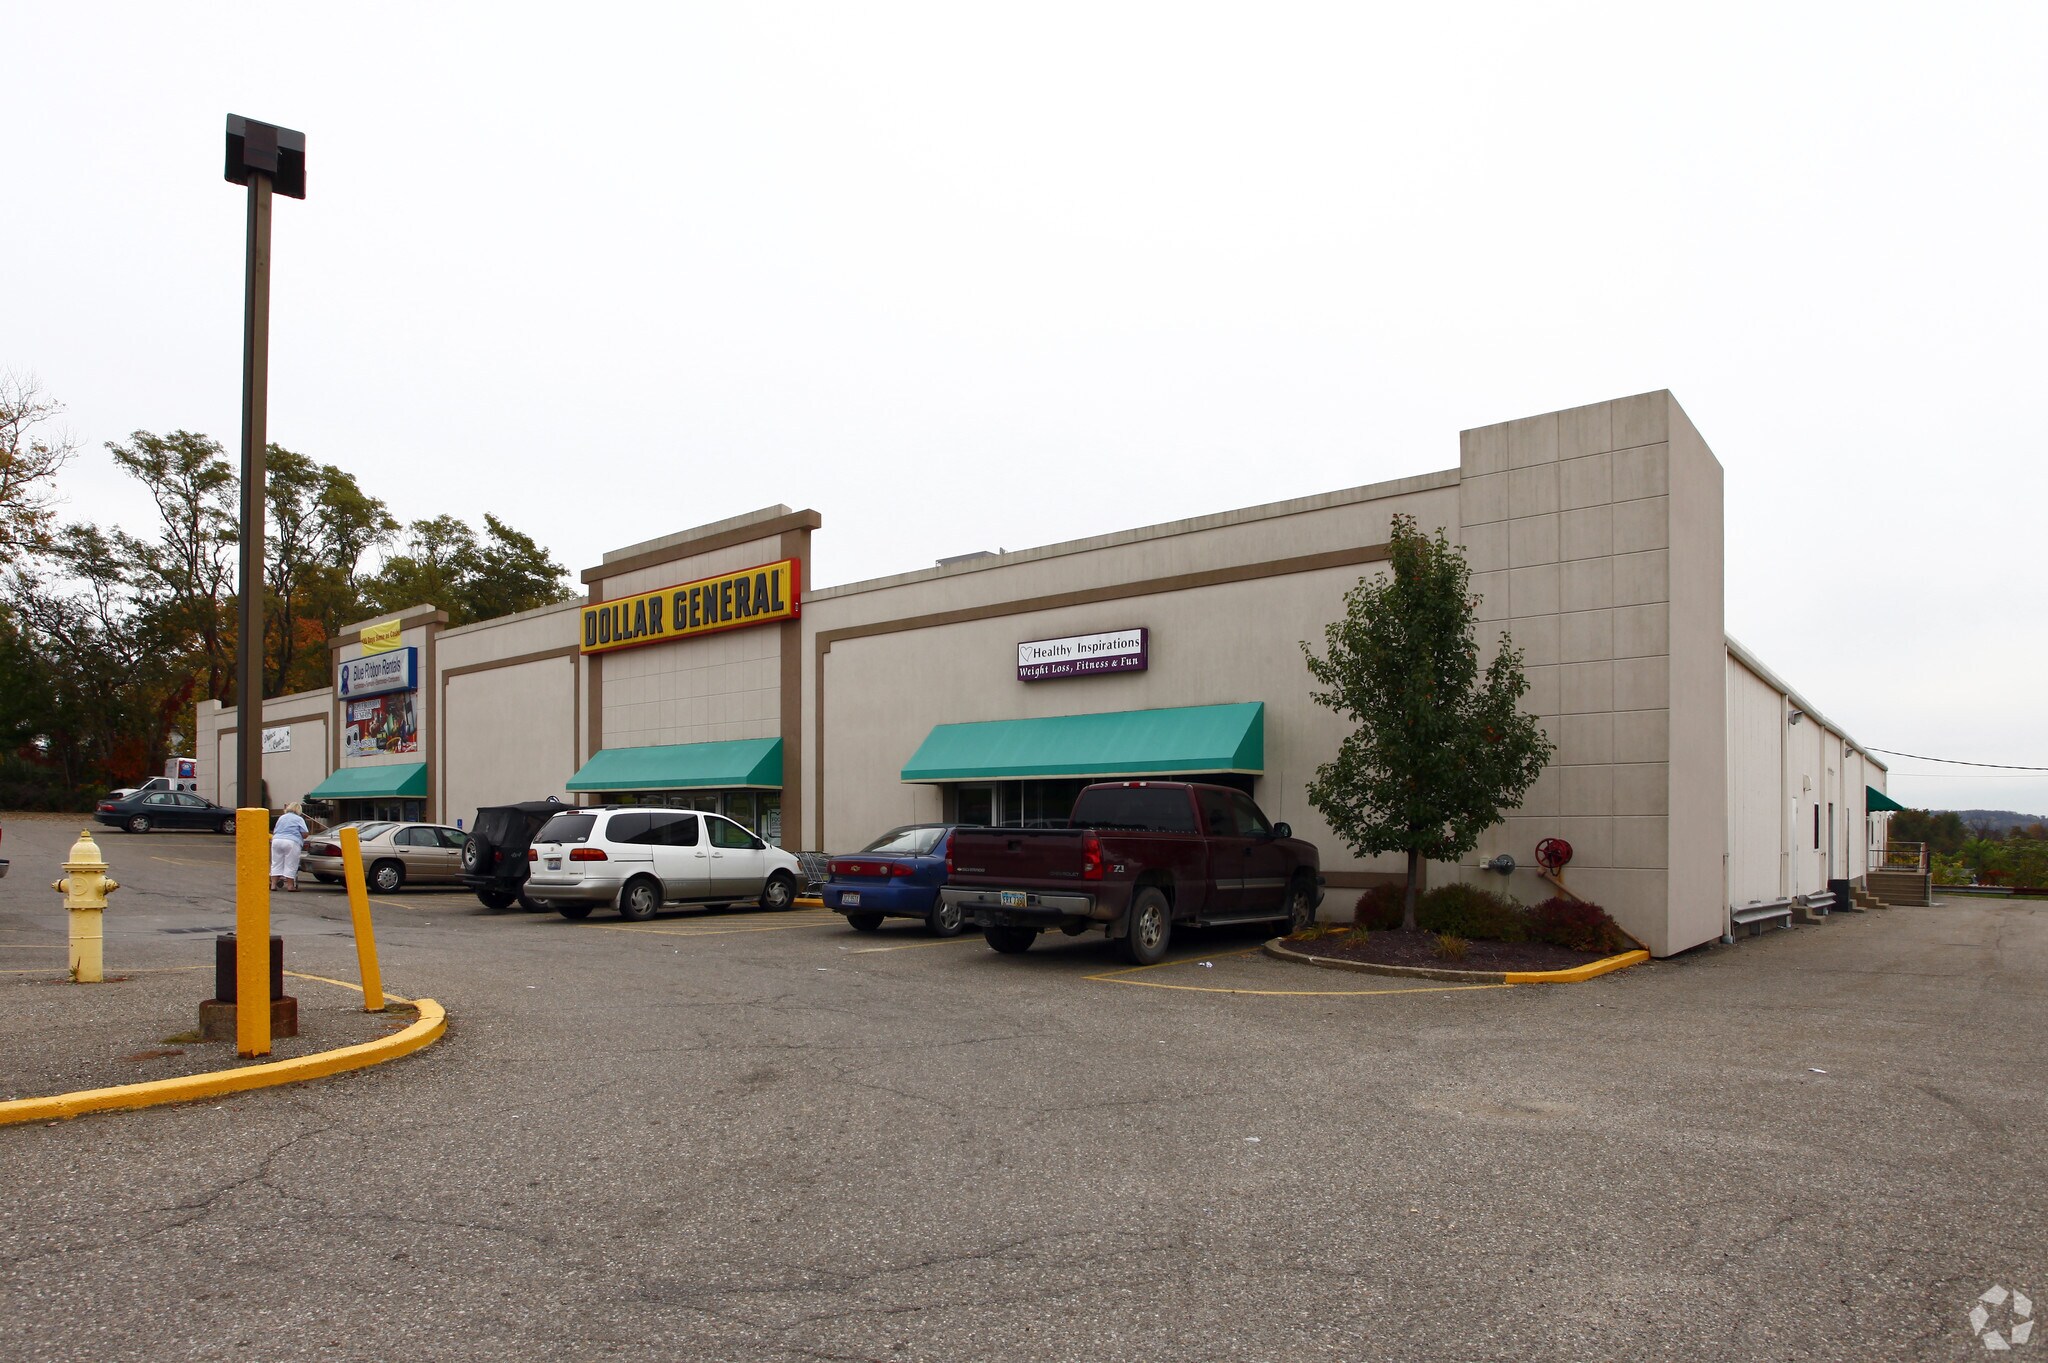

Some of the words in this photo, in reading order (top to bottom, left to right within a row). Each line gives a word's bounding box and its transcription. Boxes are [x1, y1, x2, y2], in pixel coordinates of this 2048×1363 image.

[585, 596, 663, 647] DOLLAR
[672, 569, 785, 630] GENERAL
[1033, 644, 1073, 659] Healthy
[1077, 637, 1140, 654] Inspirations
[353, 665, 365, 681] Blue
[364, 661, 381, 678] Ribbon
[382, 656, 401, 675] Rentals
[1019, 665, 1049, 678] Weight
[1052, 664, 1073, 674] Loss,
[1076, 660, 1109, 671] Fitness
[1112, 659, 1118, 667] &
[1121, 657, 1139, 667] Fun
